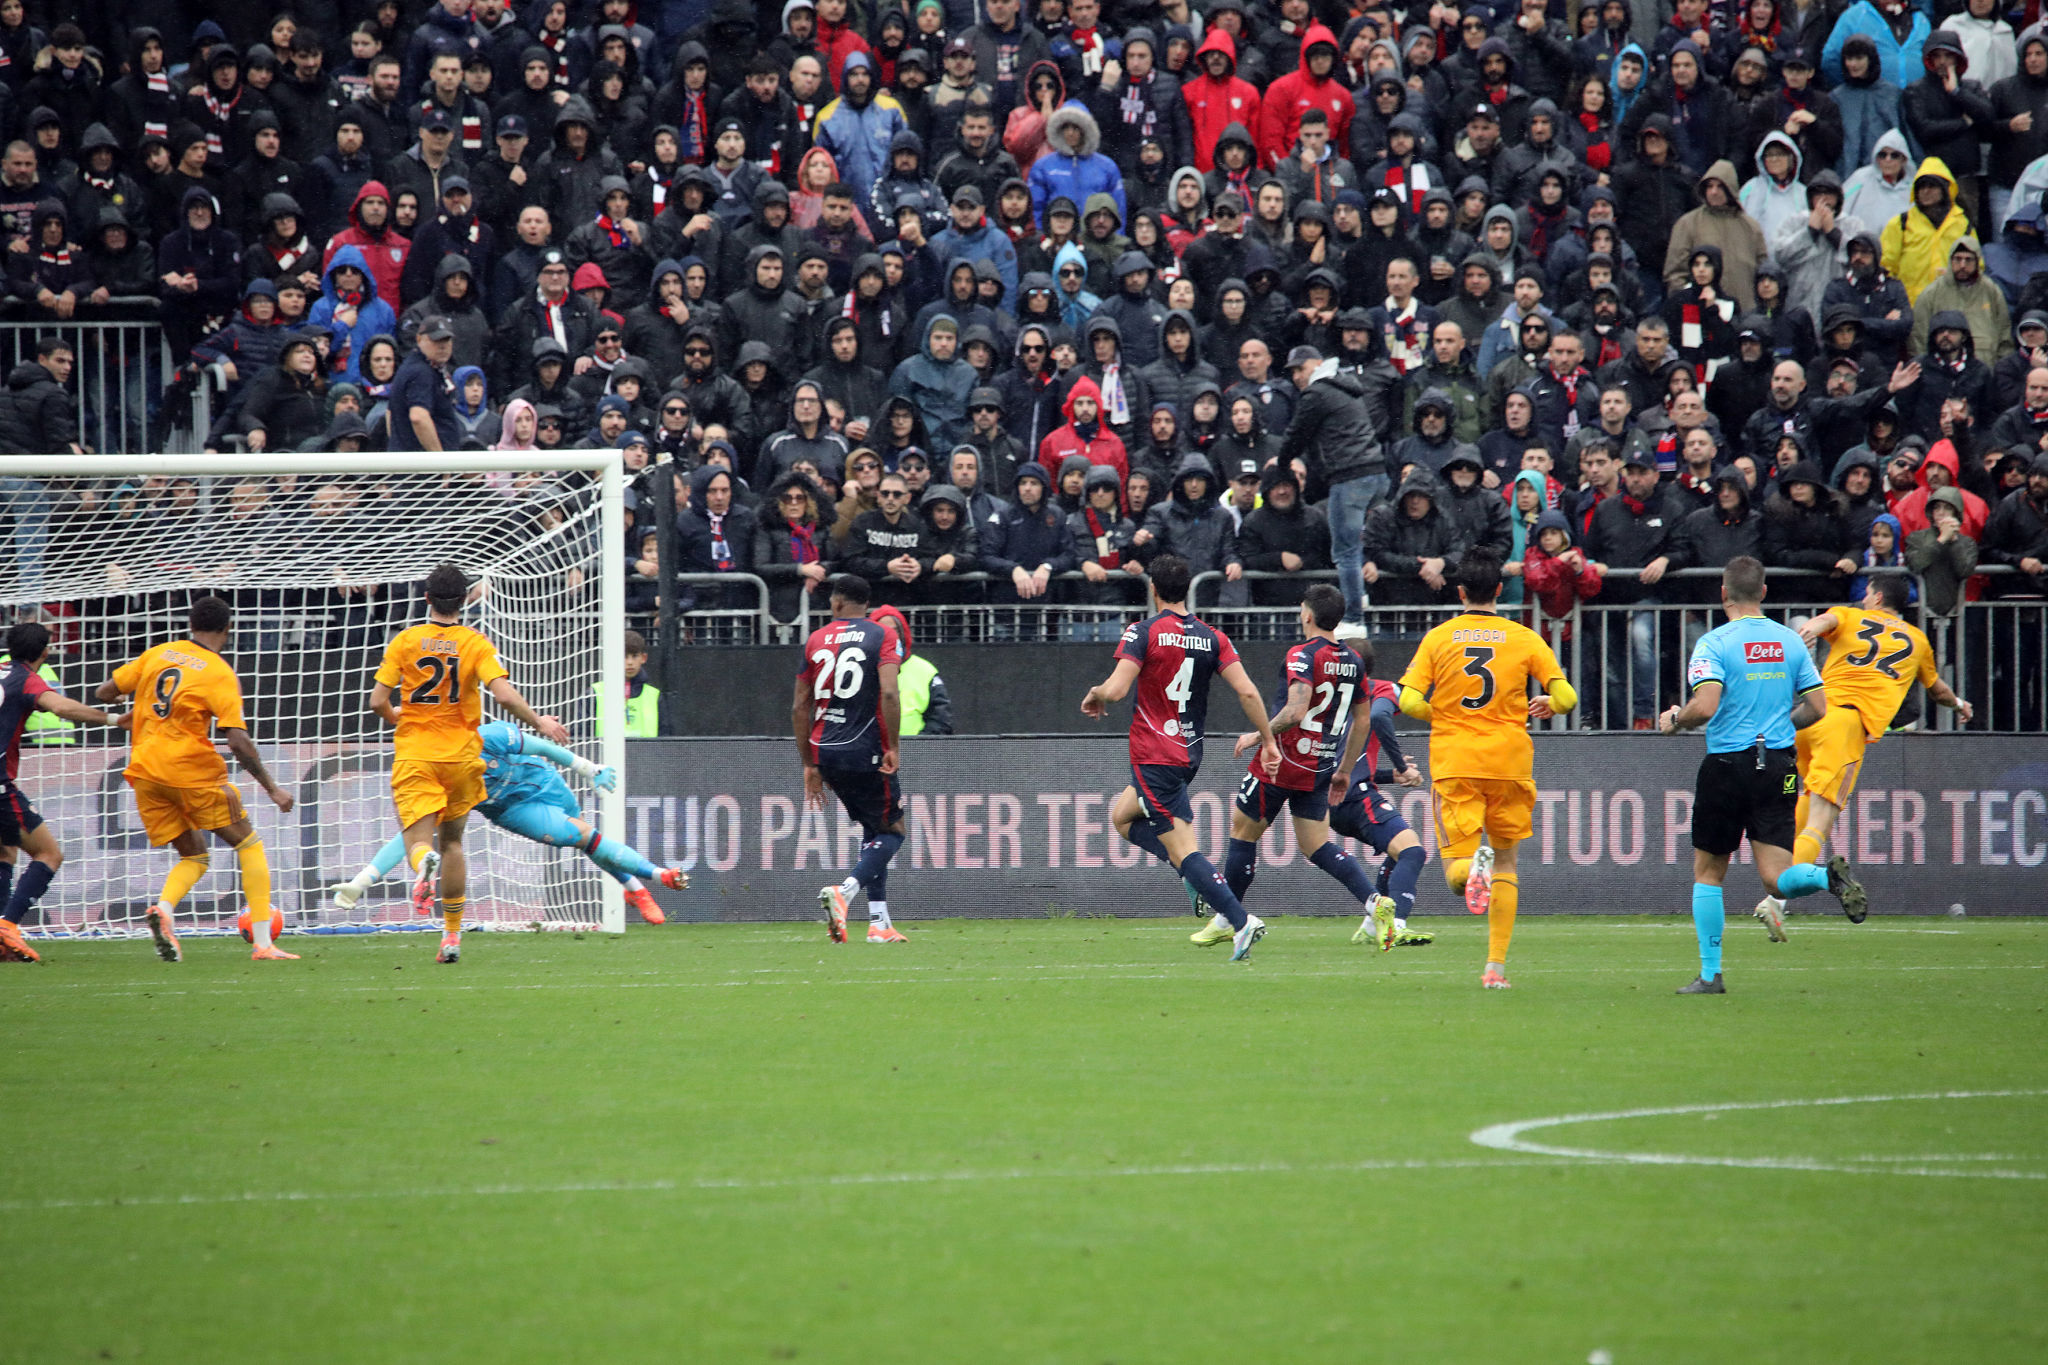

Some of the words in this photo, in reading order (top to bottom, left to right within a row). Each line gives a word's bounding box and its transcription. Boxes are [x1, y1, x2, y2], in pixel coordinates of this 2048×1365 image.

[1158, 632, 1212, 652] MAZZITELLI
[1452, 629, 1506, 643] ANGORI
[1746, 643, 1784, 660] Lete
[1846, 618, 1914, 680] 32
[152, 668, 182, 719] 9
[409, 656, 460, 704] 21
[811, 646, 867, 700] 26
[1165, 657, 1195, 714] 4
[1461, 646, 1495, 709] 3
[1299, 681, 1355, 737] 21
[625, 794, 741, 871] TUO
[760, 793, 1022, 870] PARNER
[1536, 788, 1645, 866] TUO
[1940, 788, 2048, 868] TEC
